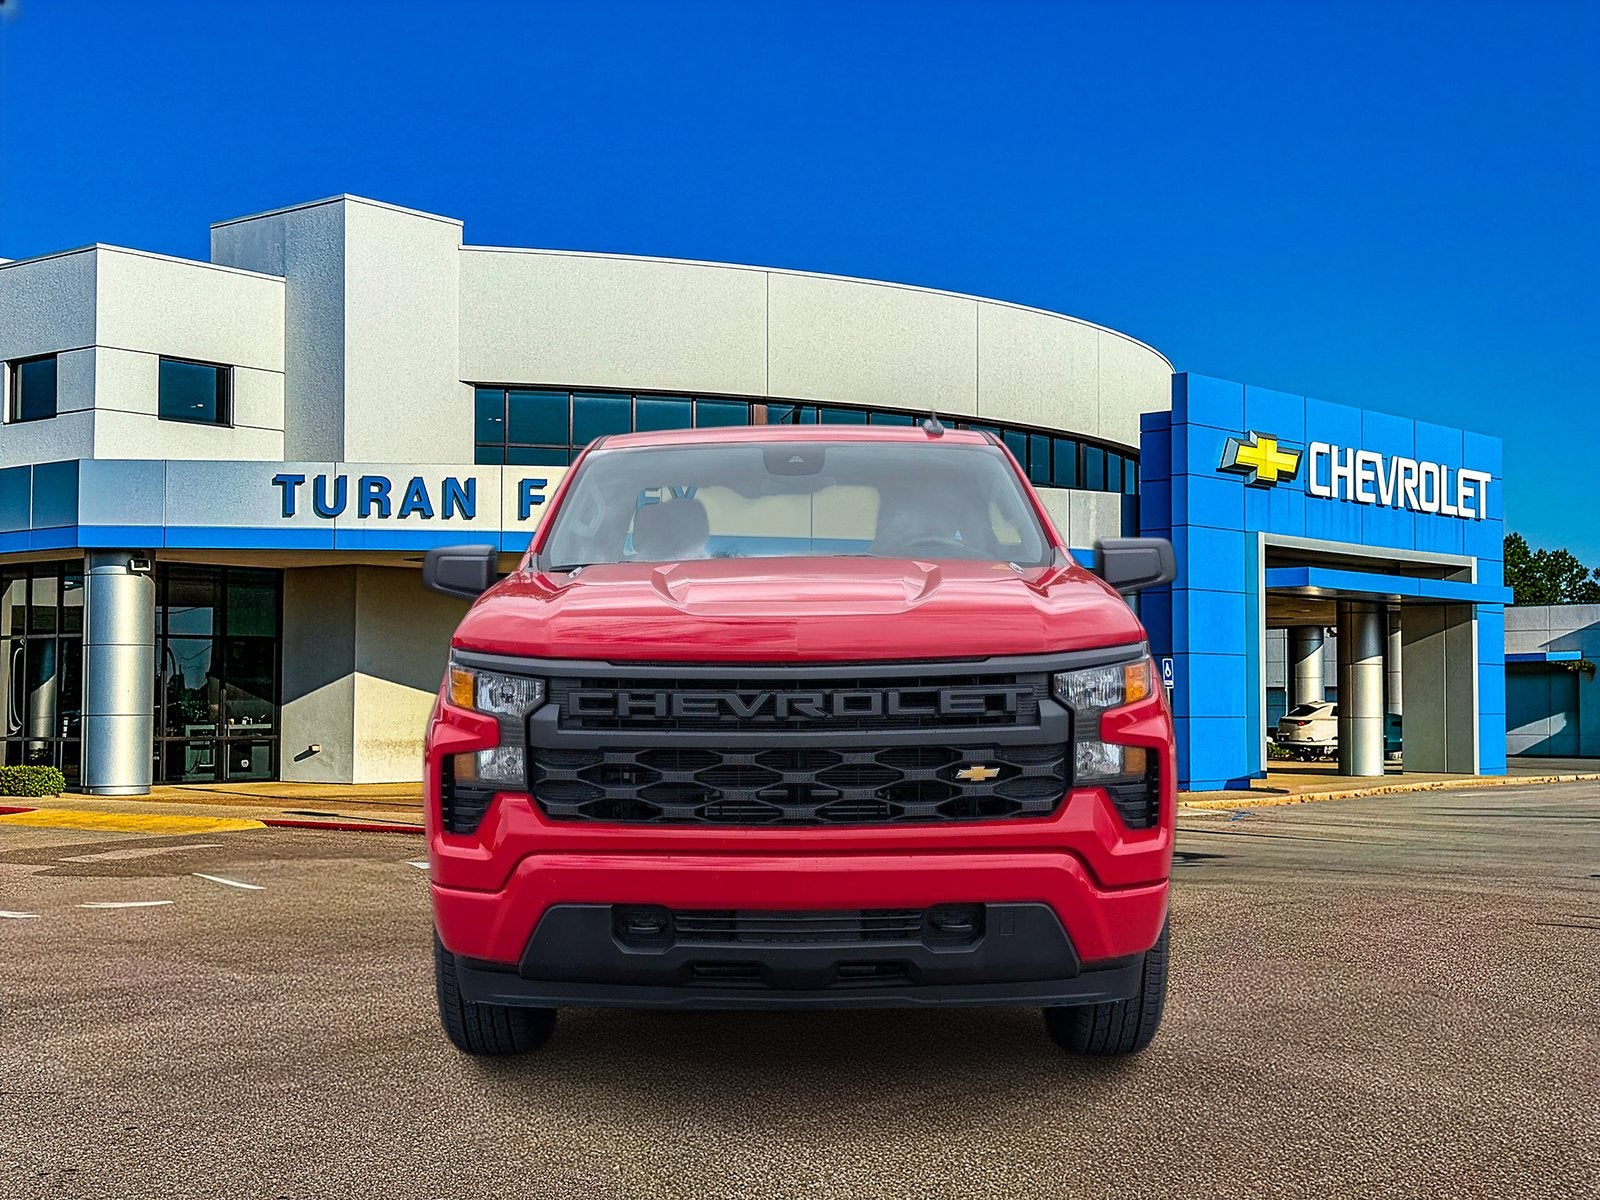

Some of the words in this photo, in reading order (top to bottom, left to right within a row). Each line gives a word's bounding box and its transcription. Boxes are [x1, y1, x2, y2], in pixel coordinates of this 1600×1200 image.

[272, 473, 477, 520] TURAN
[1307, 441, 1492, 520] CHEVROLET
[568, 687, 1033, 718] CHEVROLET
